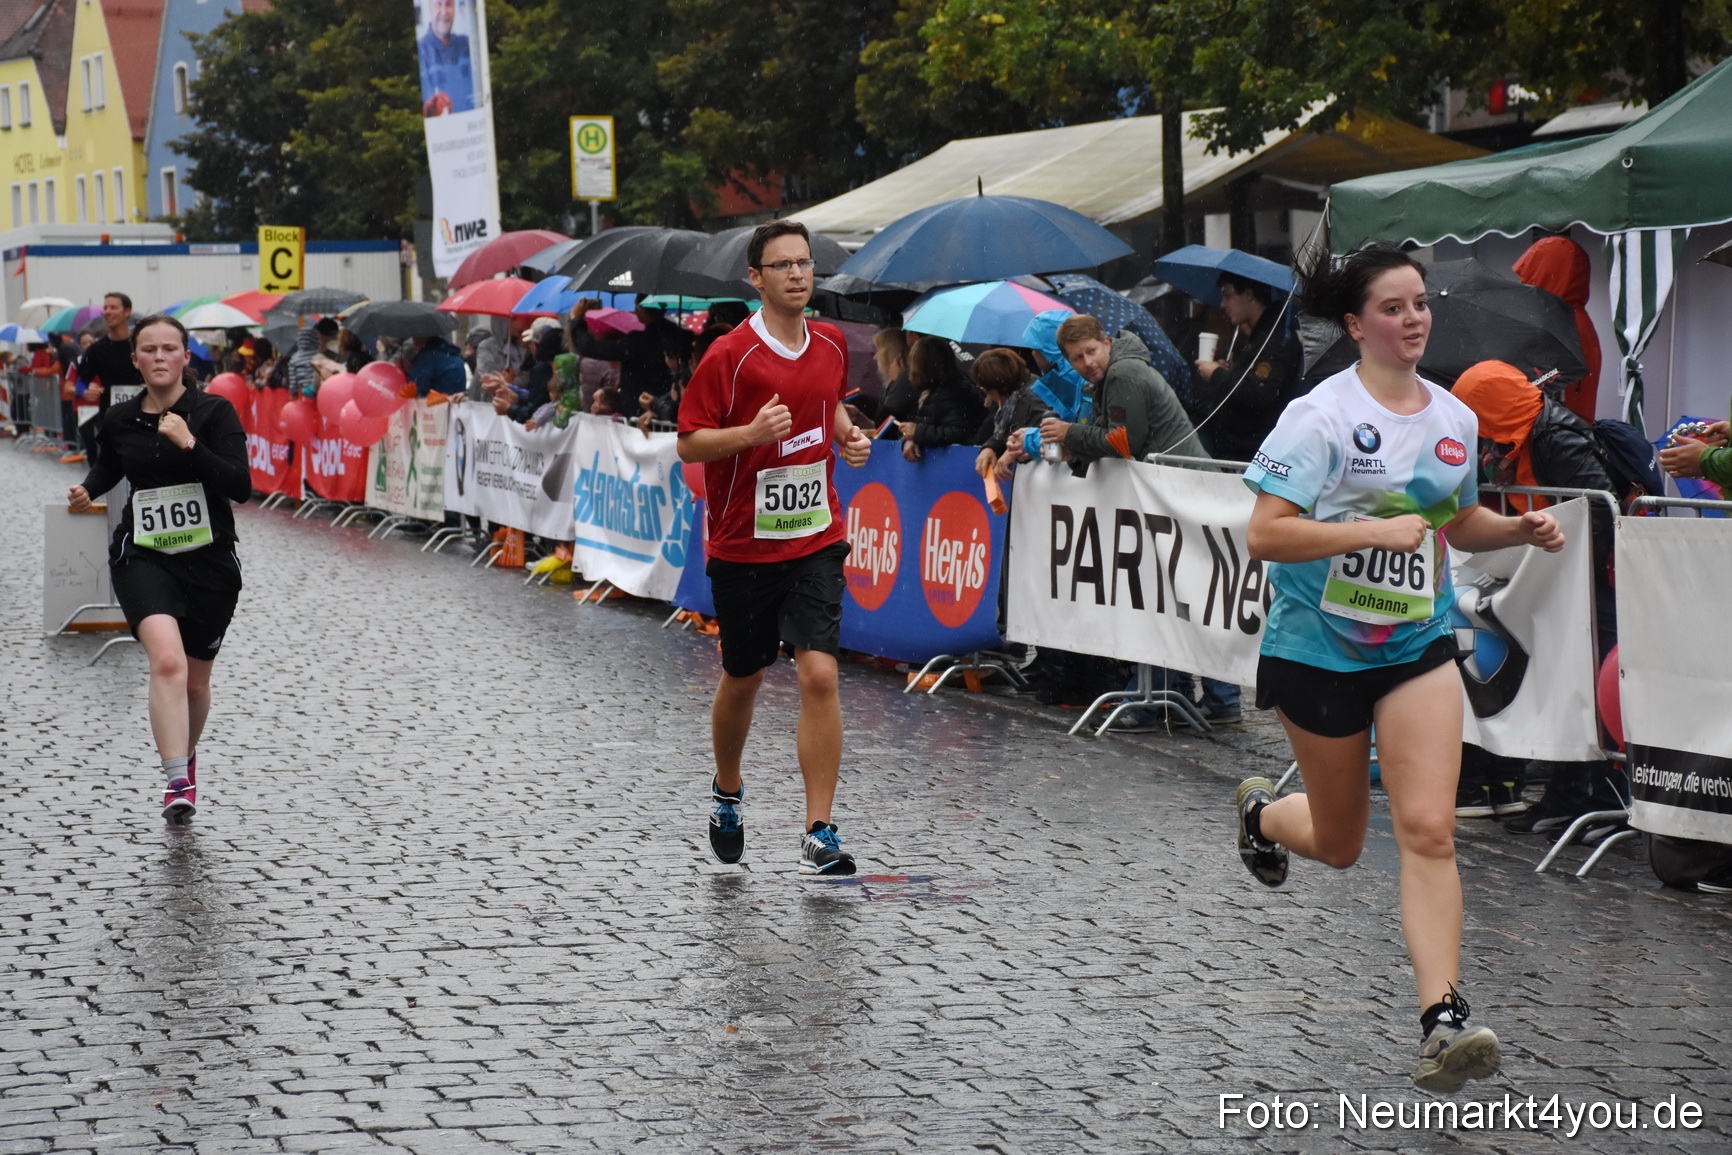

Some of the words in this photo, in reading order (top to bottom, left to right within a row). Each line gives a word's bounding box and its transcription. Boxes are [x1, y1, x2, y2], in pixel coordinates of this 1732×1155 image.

[13, 152, 35, 175] HOTEL
[264, 229, 299, 241] Block
[270, 247, 293, 280] C
[792, 435, 811, 448] DEHN
[793, 464, 821, 478] BOCK
[1351, 467, 1387, 475] Neumarkt
[1352, 458, 1386, 468] PARTL
[161, 486, 198, 499] BOCK
[765, 480, 822, 512] 5032
[141, 500, 202, 532] 5169
[775, 517, 812, 530] Andreas
[153, 534, 193, 548] Melanie
[845, 507, 899, 586] Hervis
[925, 518, 986, 602] Hervis
[1051, 504, 1191, 622] PARTL
[1202, 523, 1272, 635] Ne
[1342, 547, 1425, 591] 5096
[1349, 590, 1408, 614] Johanna
[1631, 763, 1683, 794] Leistungen,
[1684, 771, 1700, 794] die
